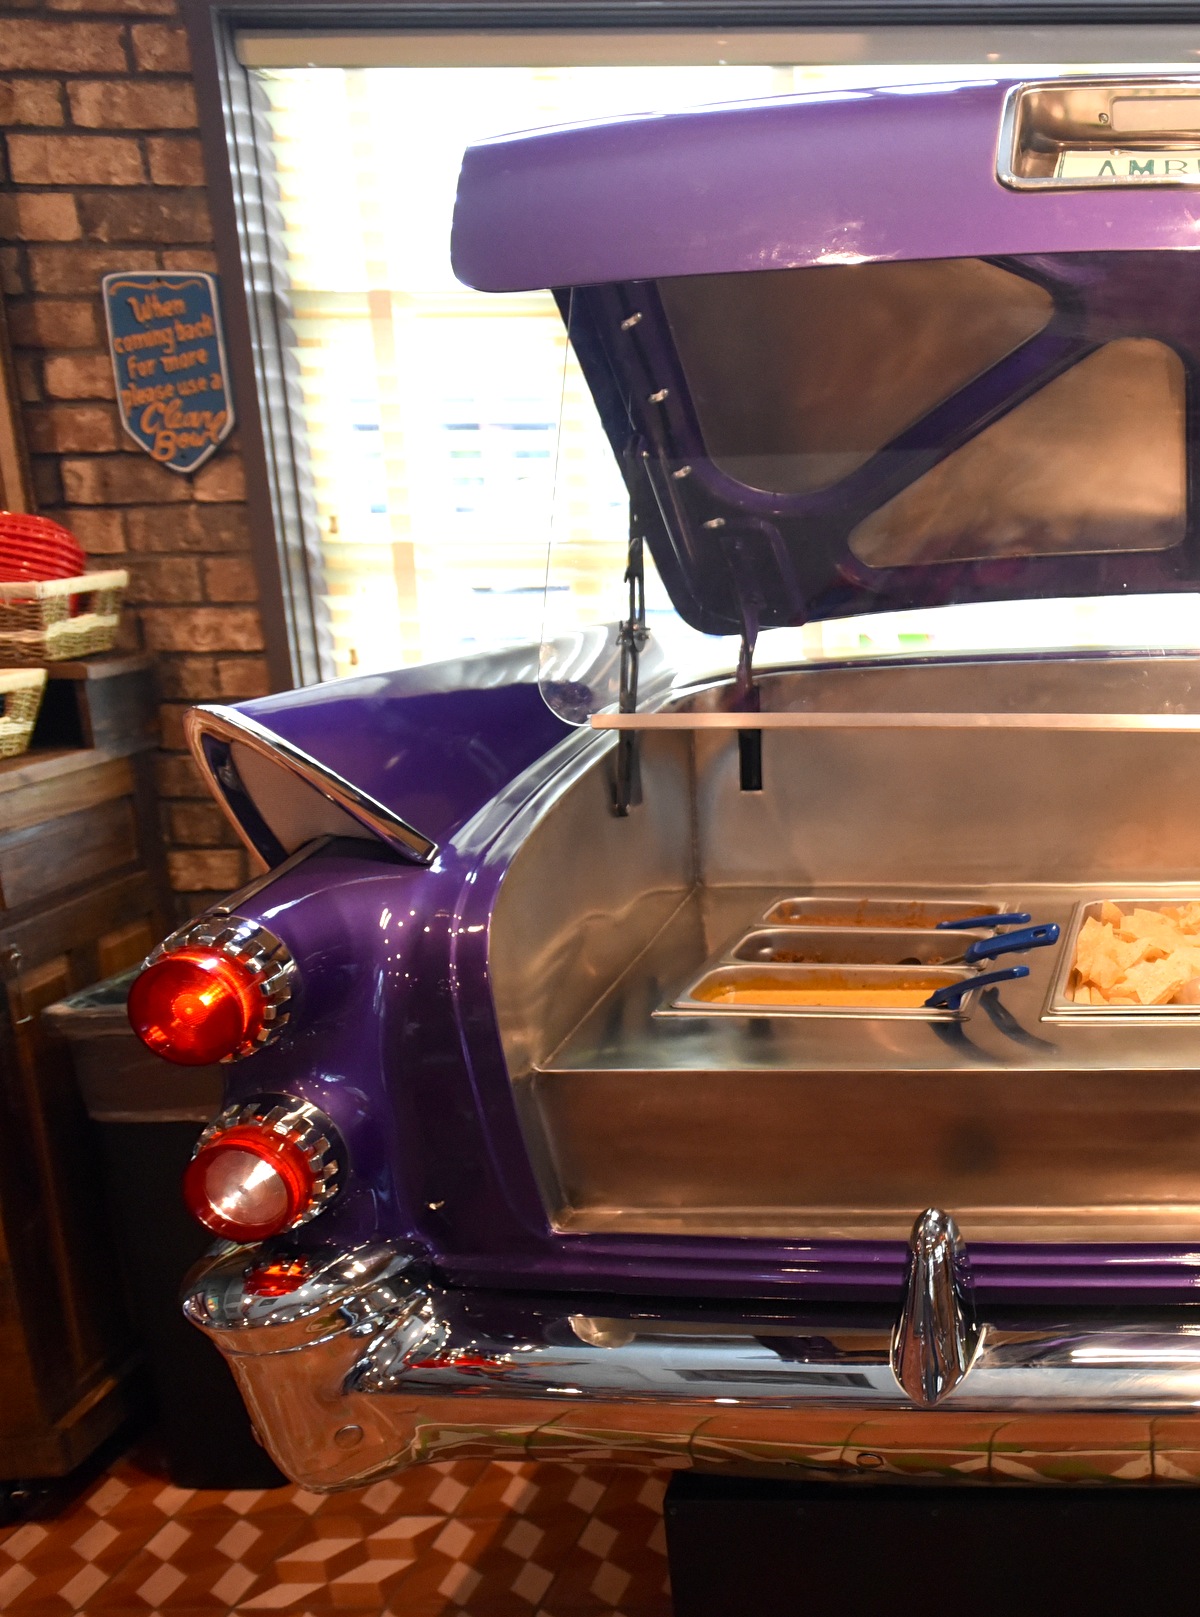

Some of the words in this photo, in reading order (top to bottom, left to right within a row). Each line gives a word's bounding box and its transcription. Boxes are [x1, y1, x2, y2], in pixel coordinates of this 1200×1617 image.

[127, 294, 187, 323] When
[113, 327, 175, 354] coming
[174, 313, 214, 342] back
[127, 355, 157, 379] for
[160, 348, 209, 373] more
[121, 382, 175, 417] please
[177, 377, 208, 396] use
[210, 372, 222, 390] a
[140, 398, 213, 435] Clean
[151, 411, 227, 462] Bowl
